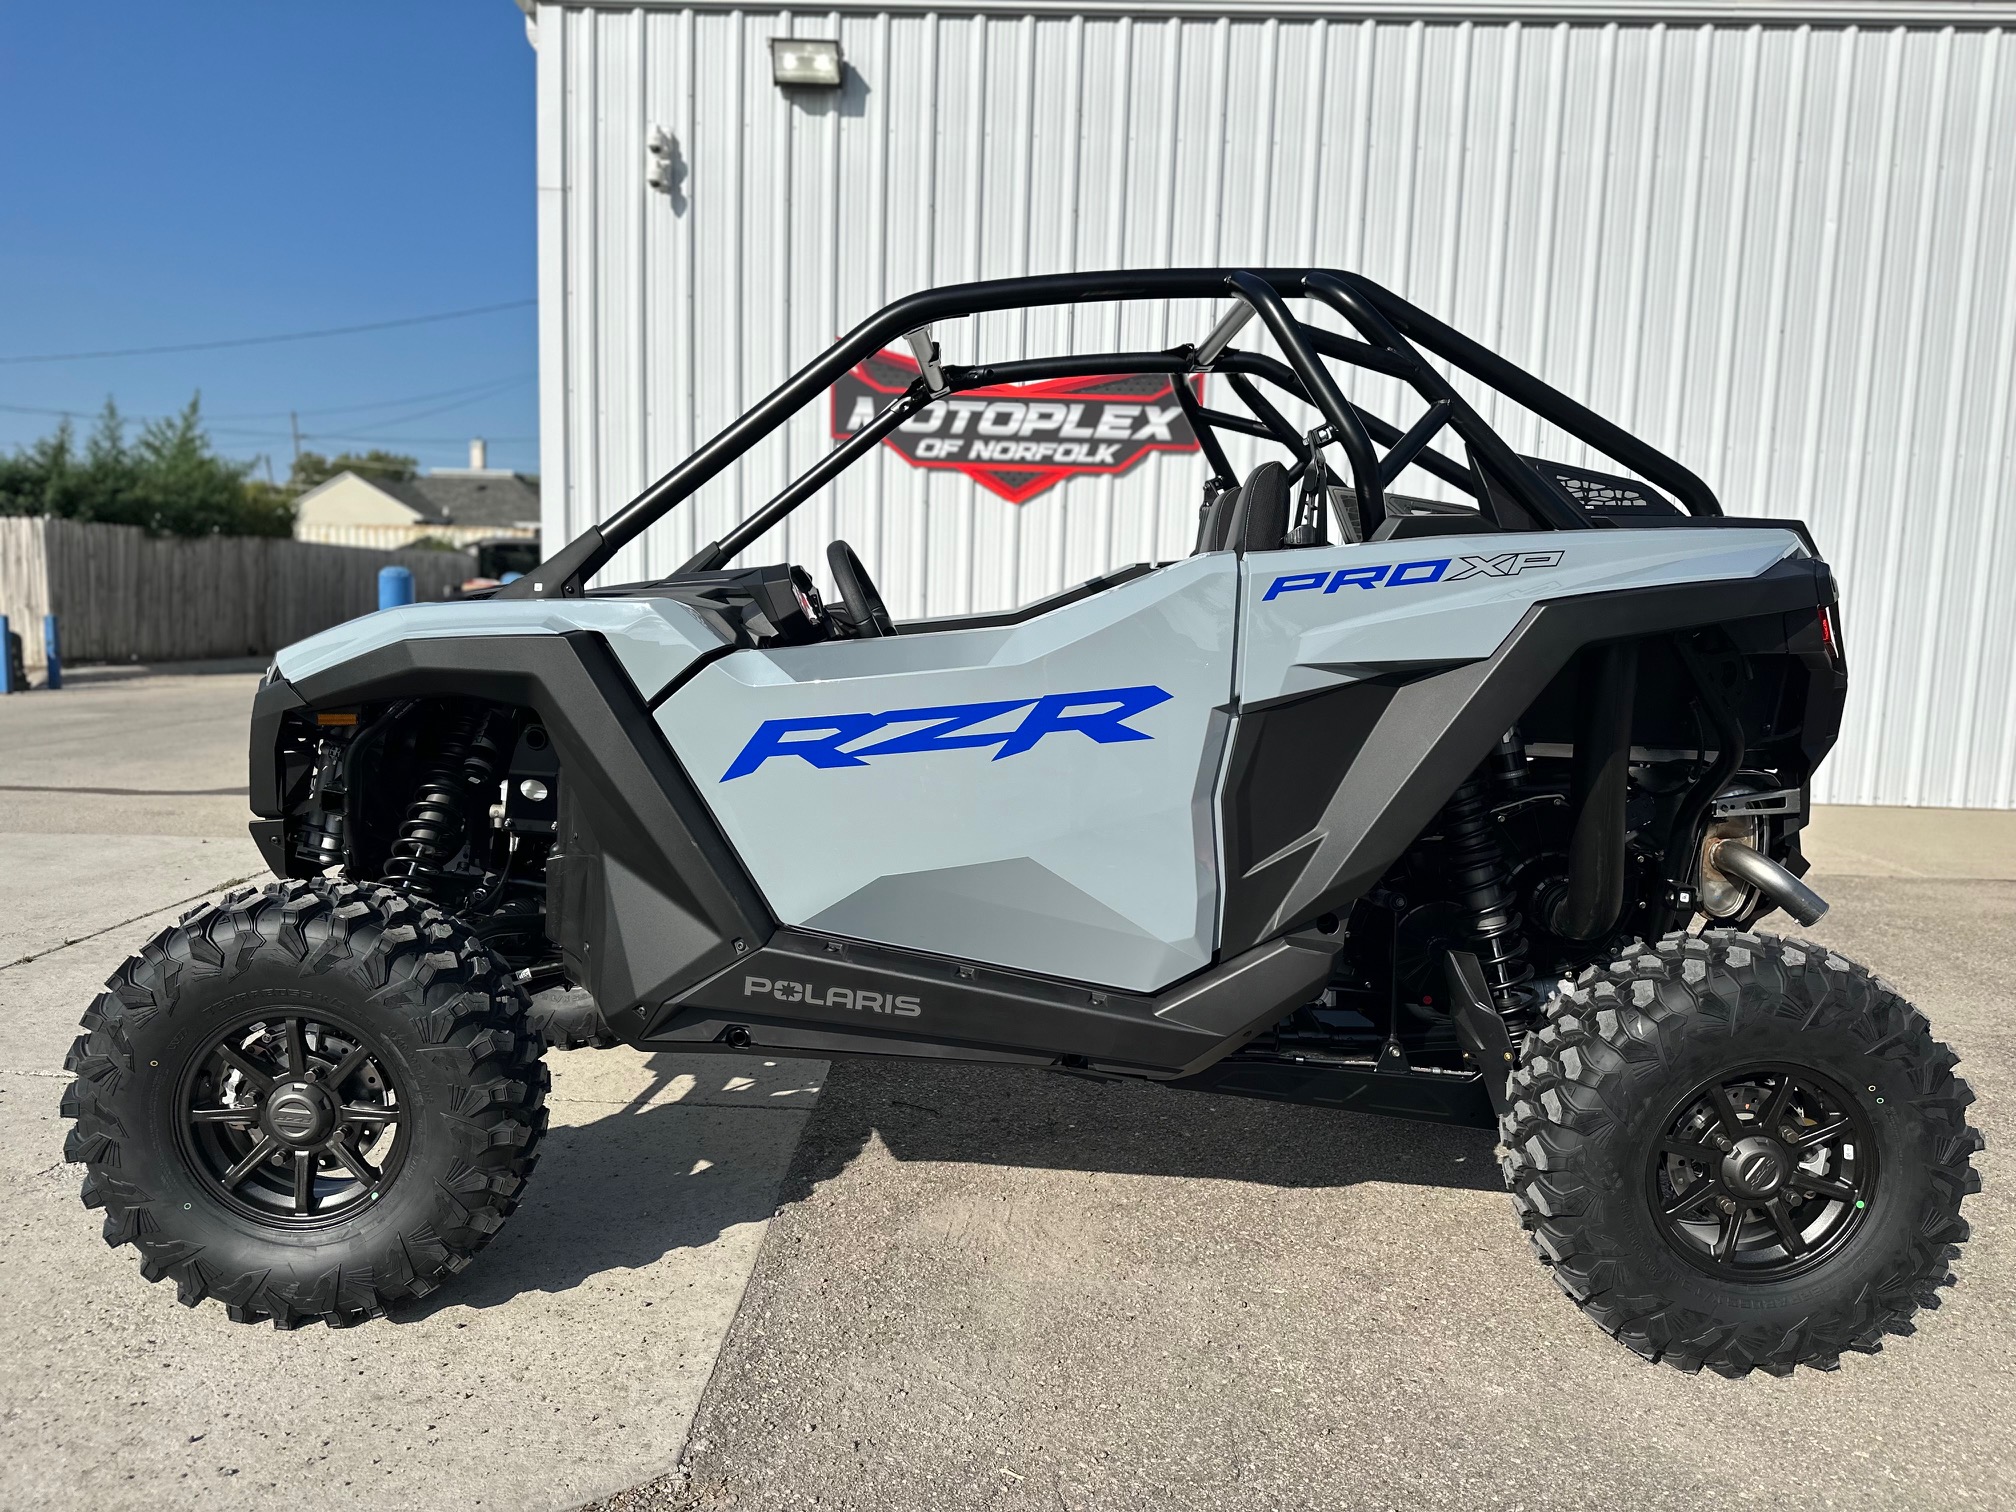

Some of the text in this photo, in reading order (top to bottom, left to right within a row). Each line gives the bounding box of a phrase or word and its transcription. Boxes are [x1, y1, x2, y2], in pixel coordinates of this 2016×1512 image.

[915, 438, 1122, 464] OF NORFOLK
[719, 685, 1174, 783] RZR
[744, 976, 921, 1017] POLARIS
